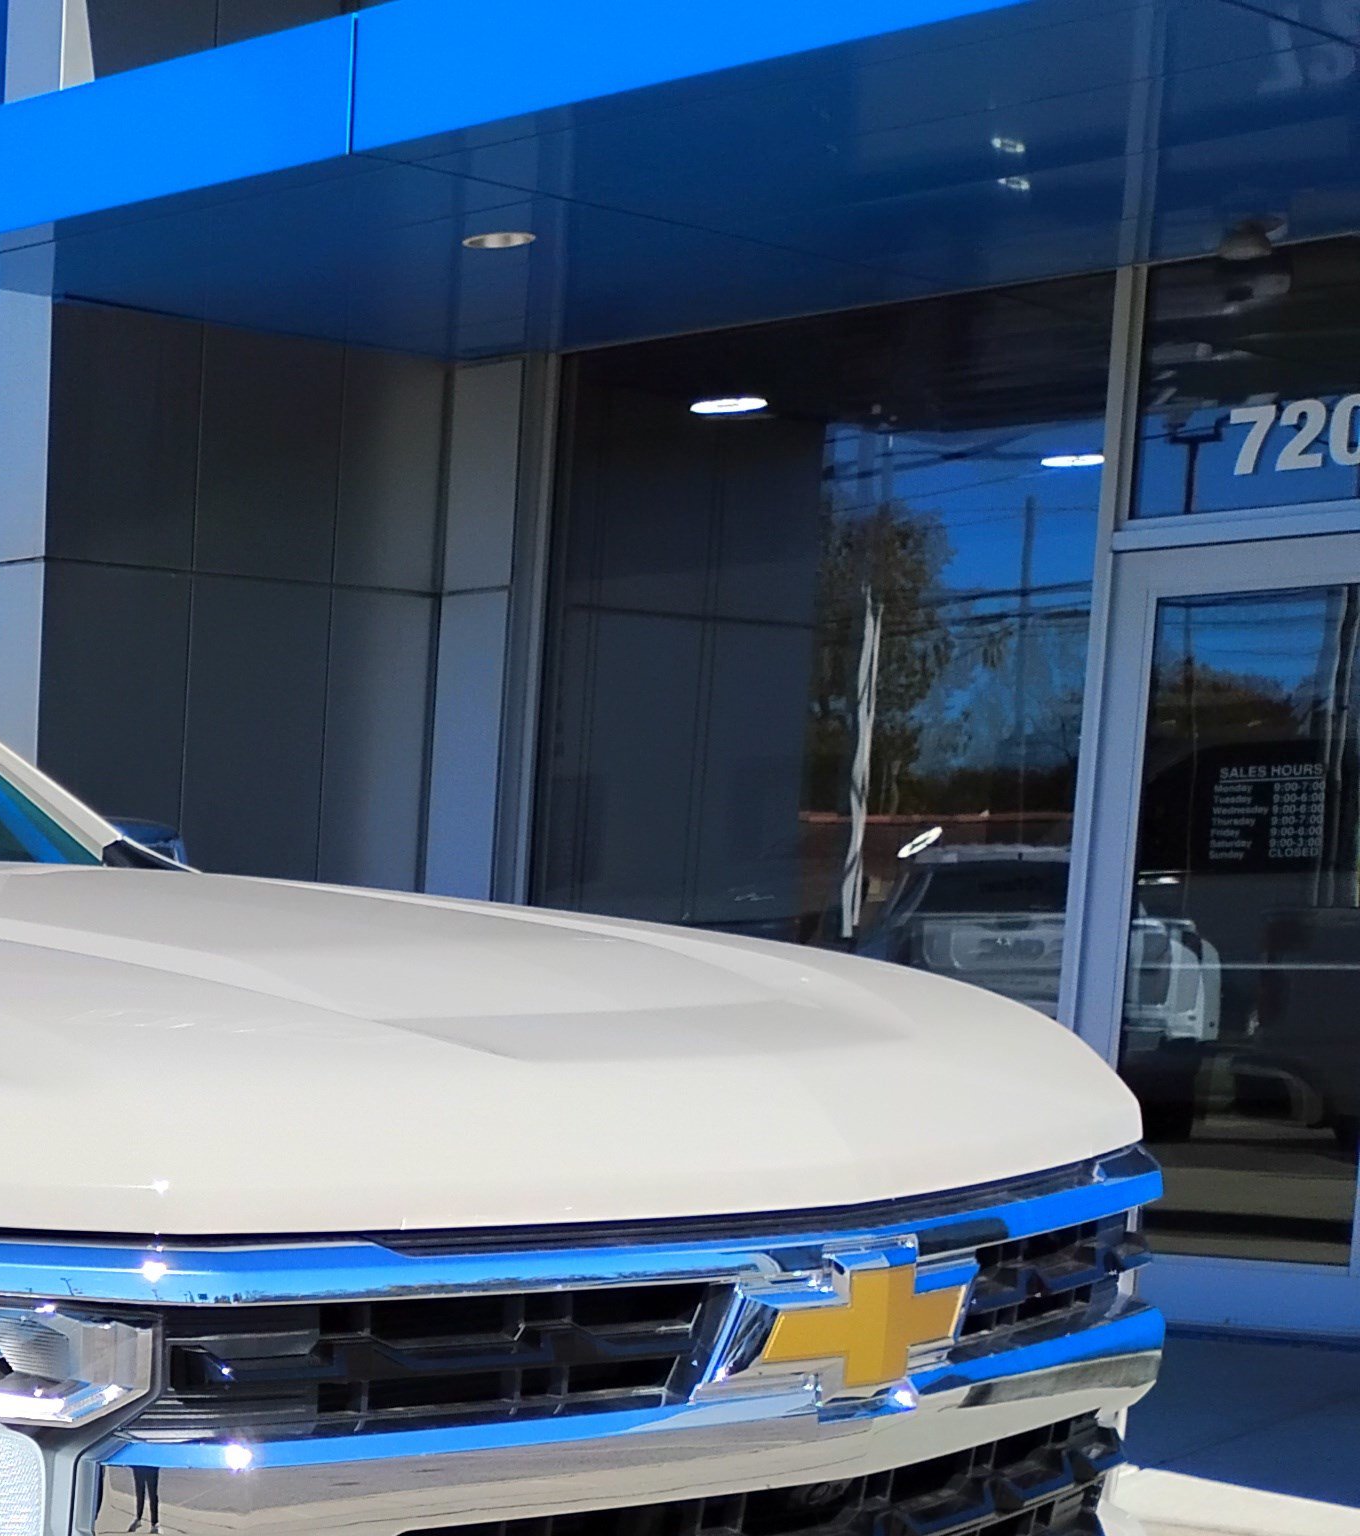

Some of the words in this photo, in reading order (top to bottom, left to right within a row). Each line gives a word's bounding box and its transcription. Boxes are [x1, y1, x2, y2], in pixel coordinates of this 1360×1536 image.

[1220, 765, 1267, 779] SALES
[1271, 763, 1323, 777] HOURS
[1268, 847, 1321, 858] CLOSED
